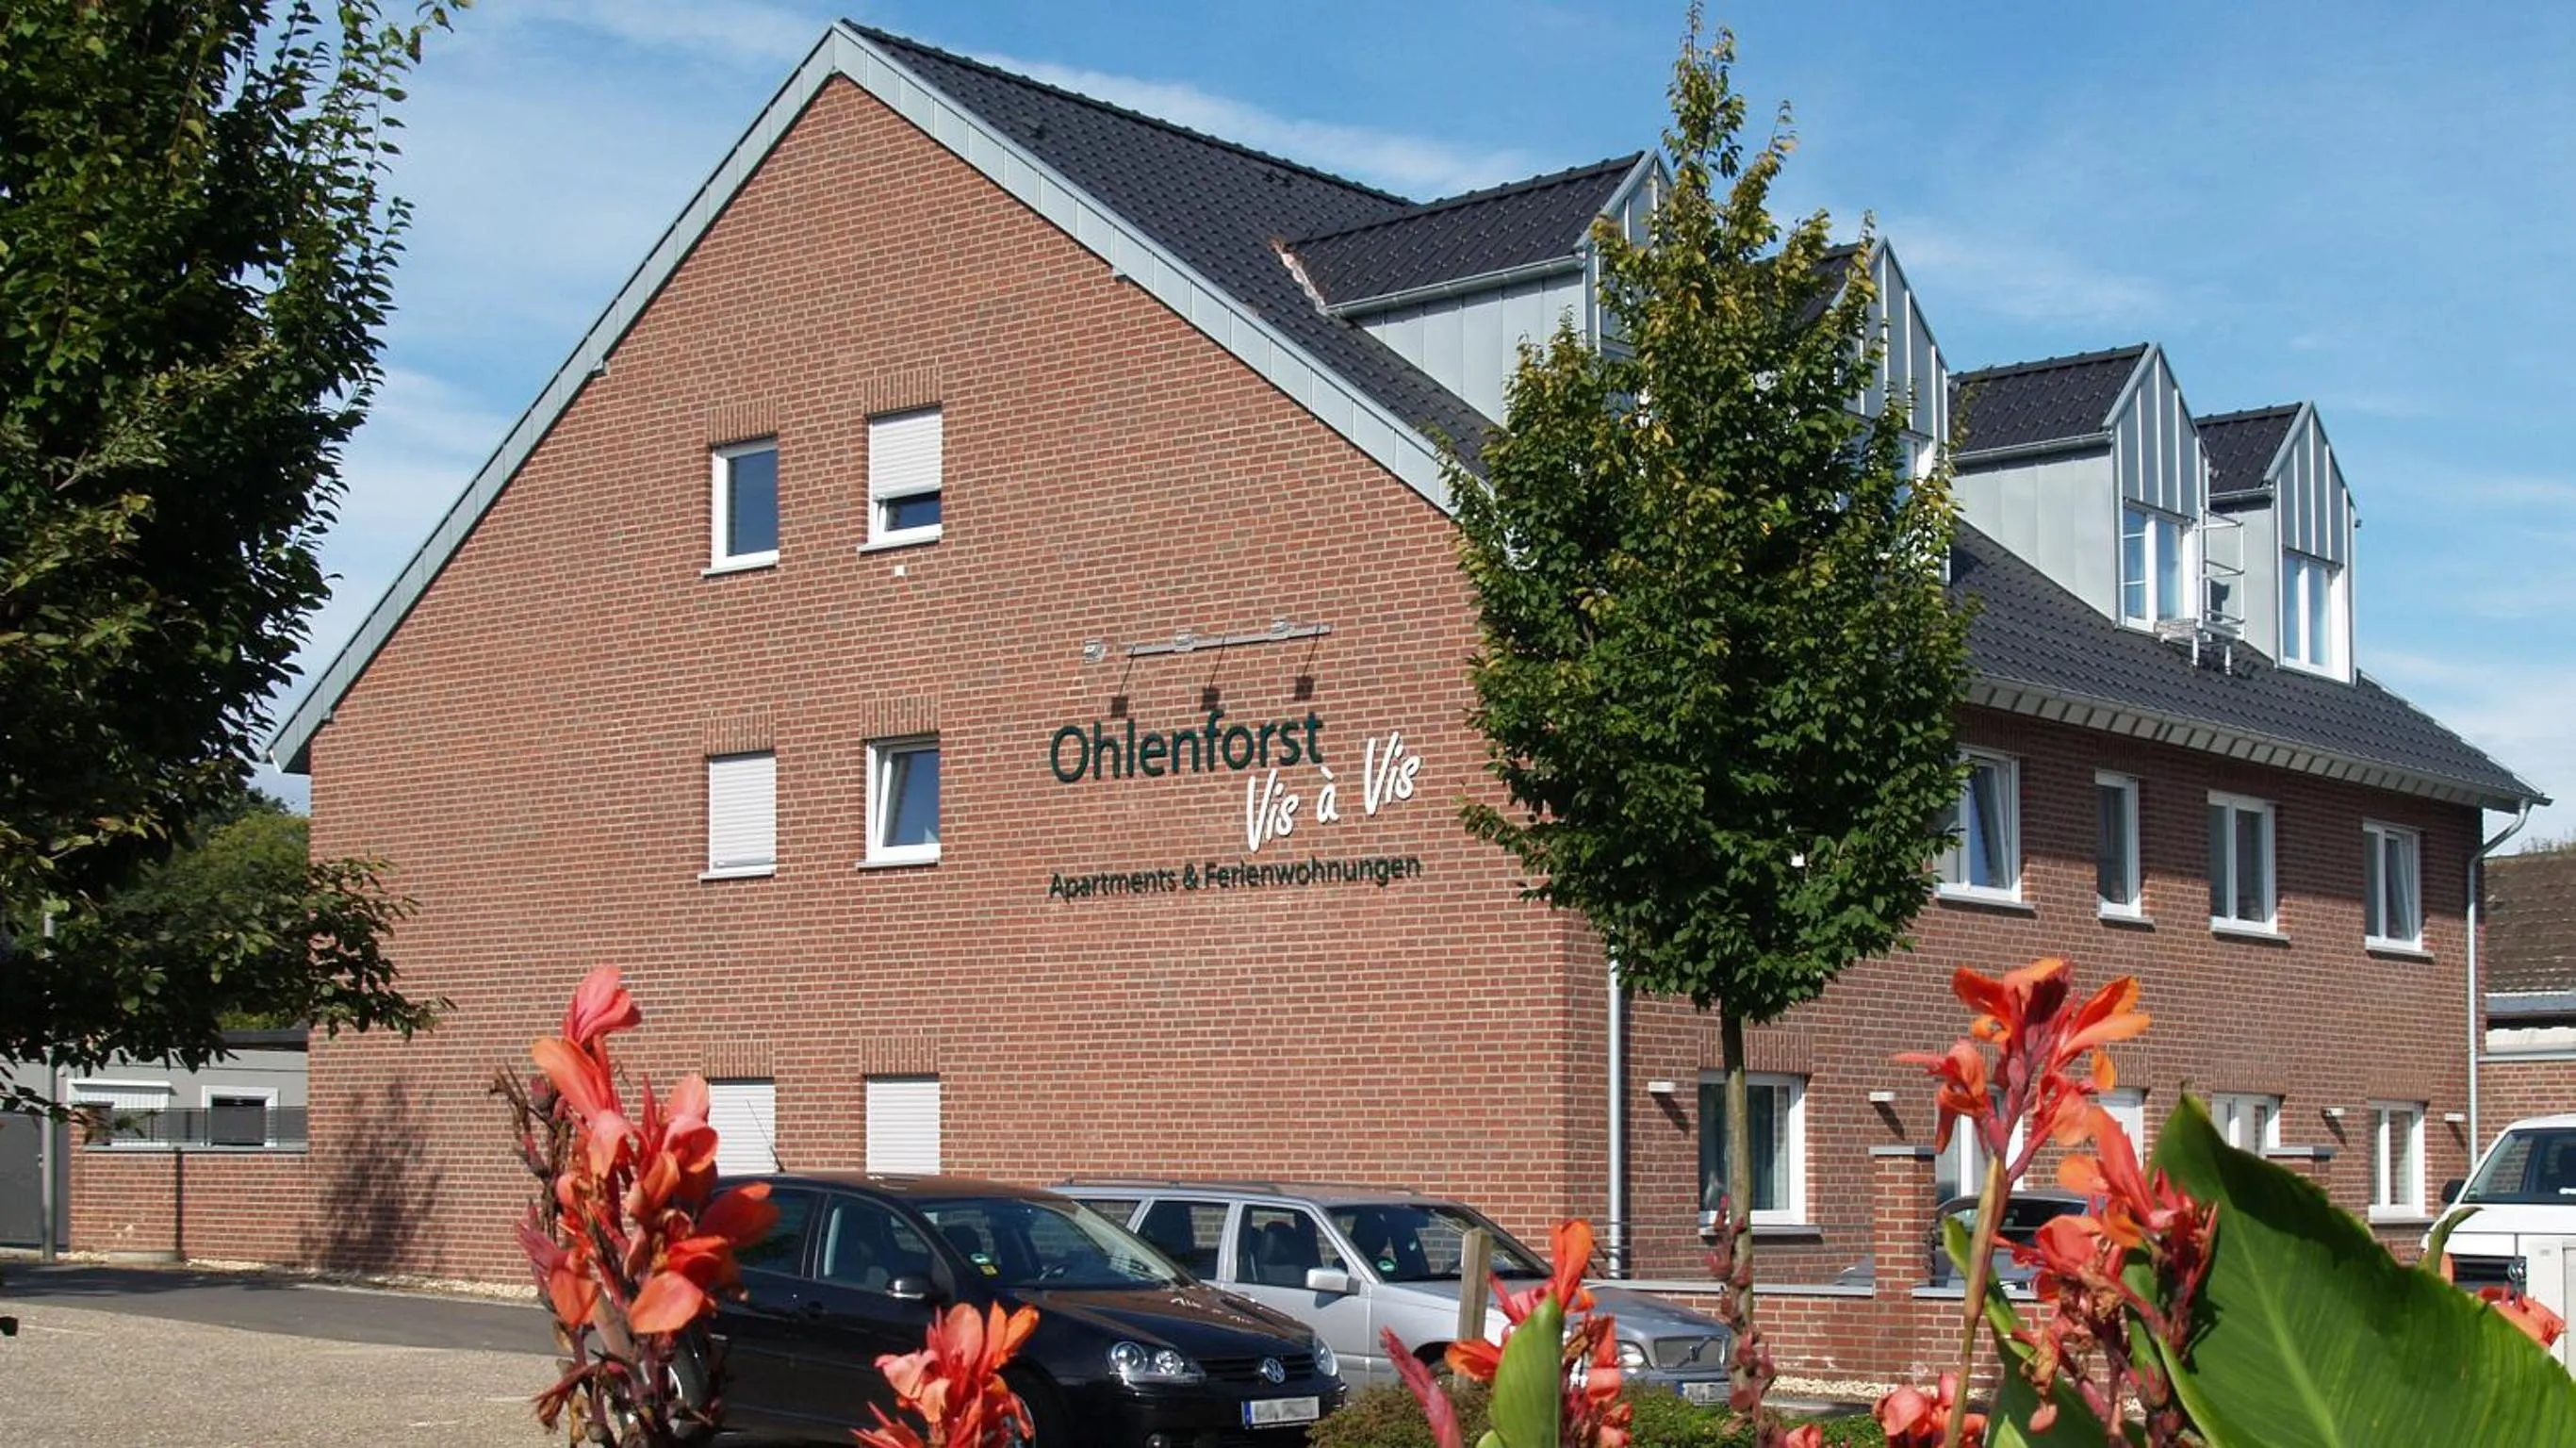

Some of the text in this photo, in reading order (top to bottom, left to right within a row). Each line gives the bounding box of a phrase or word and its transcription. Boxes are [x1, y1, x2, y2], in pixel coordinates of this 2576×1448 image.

[1050, 709, 1323, 783] Ohlenforst
[1245, 732, 1420, 852] Vis à Vis
[1049, 855, 1421, 903] Apartments & Ferienwohnungen
